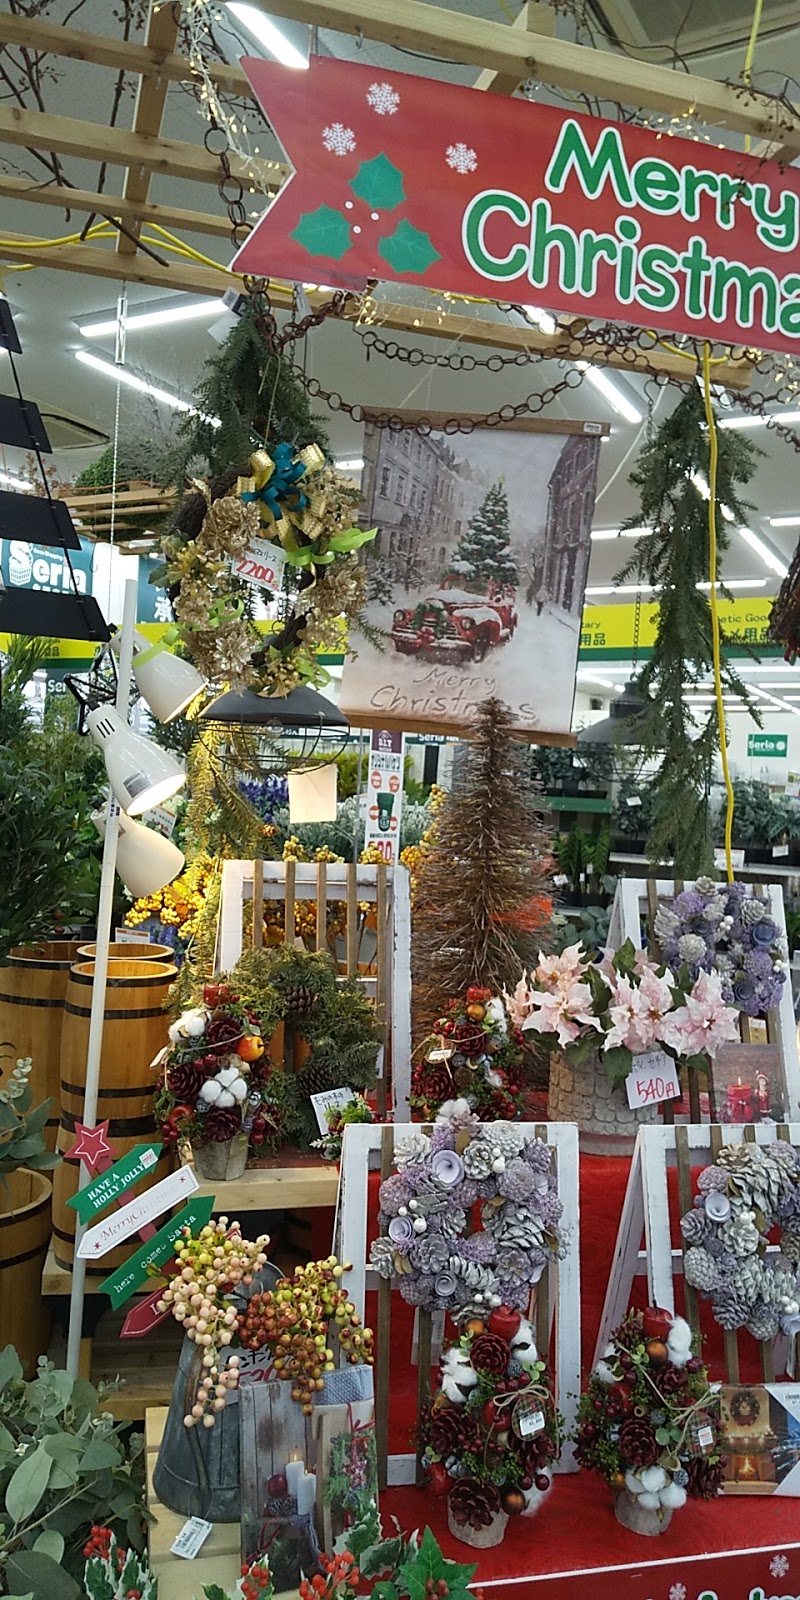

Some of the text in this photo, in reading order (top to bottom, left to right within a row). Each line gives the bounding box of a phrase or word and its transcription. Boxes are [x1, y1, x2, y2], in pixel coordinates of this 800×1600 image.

[545, 119, 798, 252] Merry
[9, 540, 87, 594] Seria
[745, 613, 769, 622] Goo
[581, 633, 606, 646] 用品
[413, 668, 497, 696] Merry
[748, 740, 775, 749] Seria
[636, 1077, 676, 1103] 540円
[87, 1172, 120, 1200] HAVE A
[92, 1162, 146, 1208] HOLLY JOLLY
[113, 1273, 135, 1293] here
[167, 1215, 197, 1242] Santa
